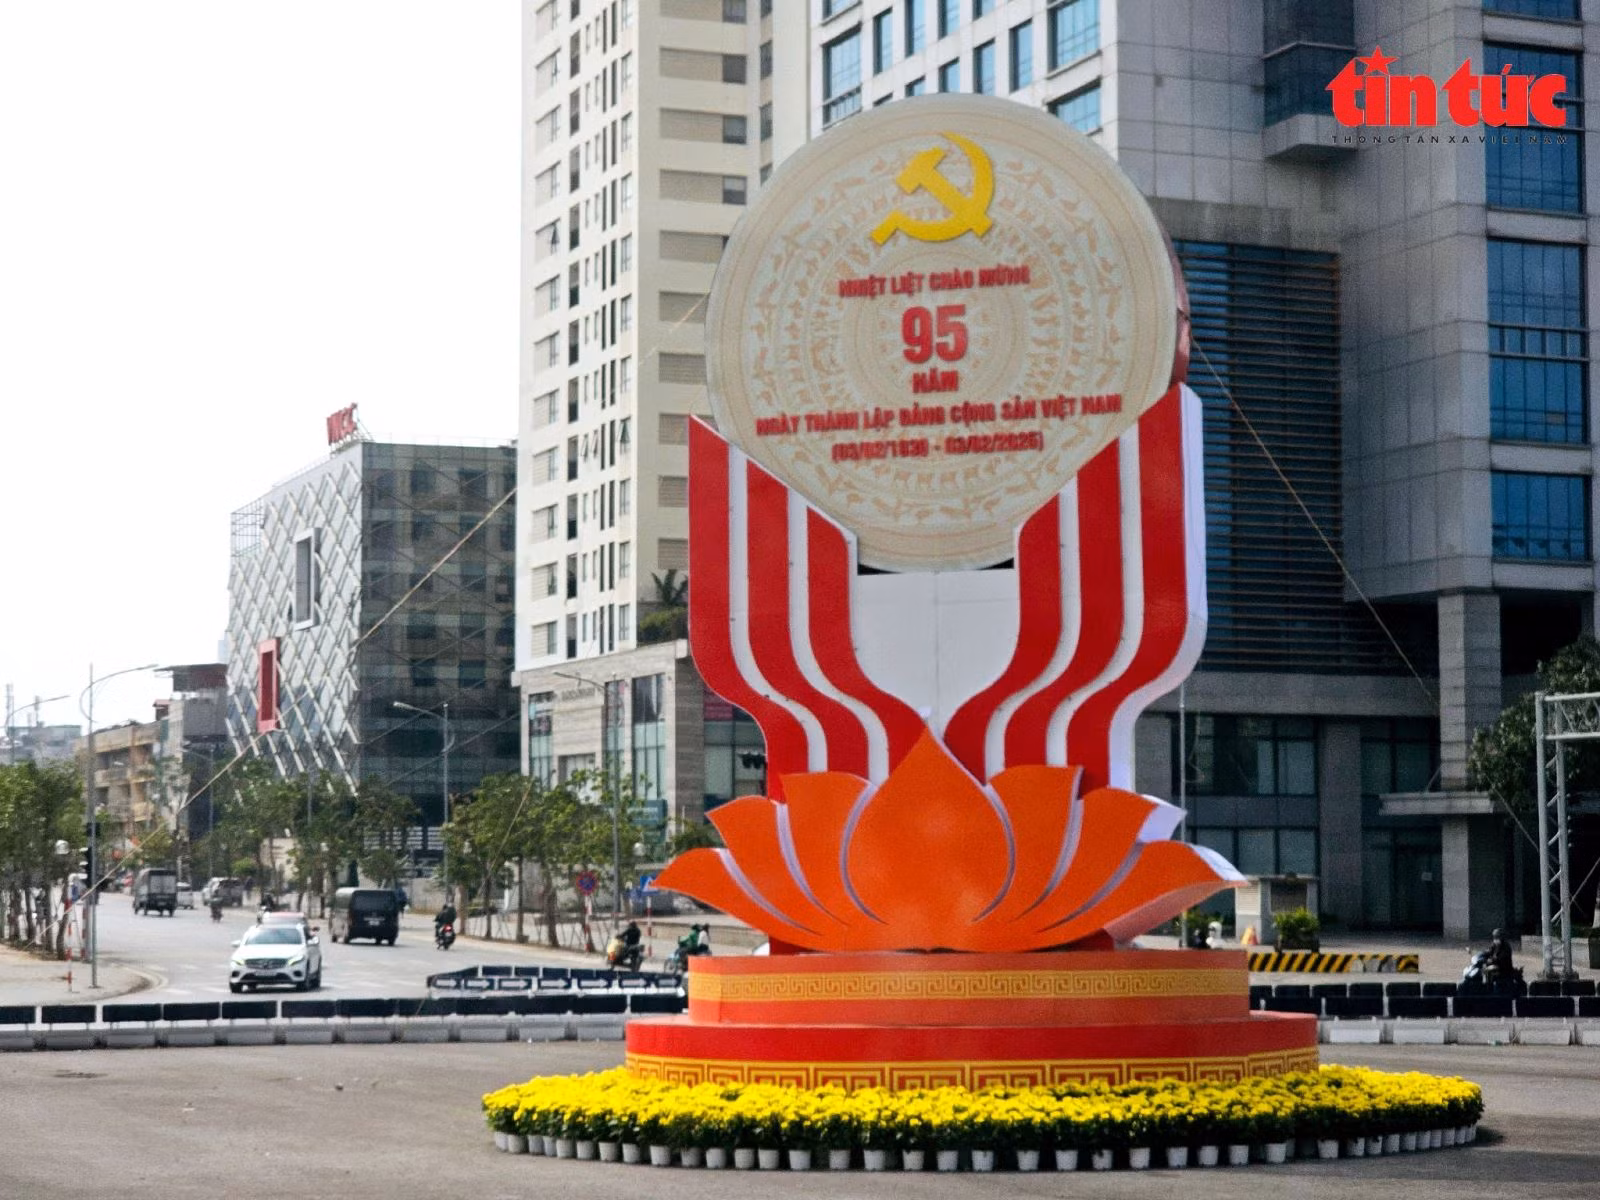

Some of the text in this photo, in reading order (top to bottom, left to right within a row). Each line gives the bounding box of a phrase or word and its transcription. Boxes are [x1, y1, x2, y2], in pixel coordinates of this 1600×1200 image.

[890, 270, 924, 297] LIỆT
[902, 304, 968, 364] 95
[1001, 394, 1037, 420] SẢN
[1041, 394, 1077, 421] VIỆT
[1081, 394, 1122, 416] NAM
